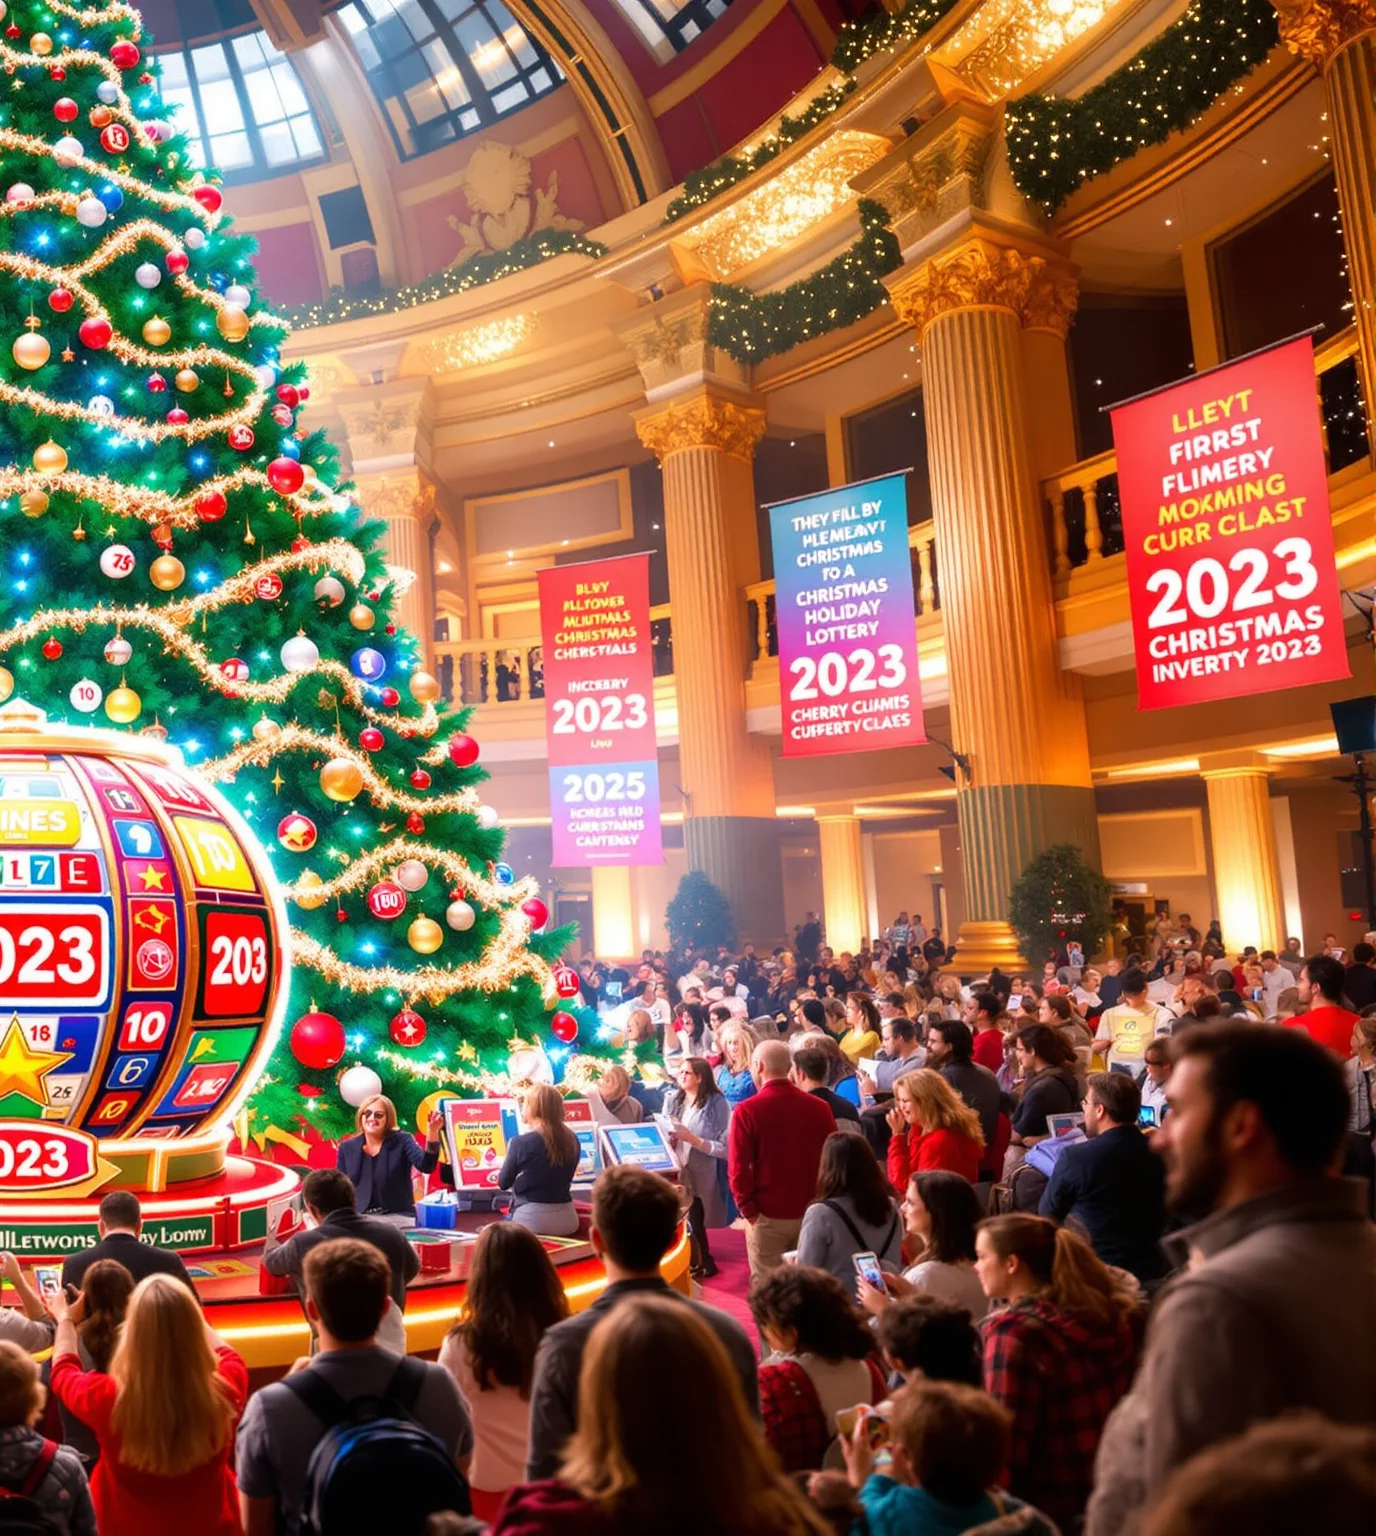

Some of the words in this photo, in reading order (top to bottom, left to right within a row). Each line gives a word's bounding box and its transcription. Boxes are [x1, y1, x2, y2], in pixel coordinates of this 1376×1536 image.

[1172, 389, 1252, 434] LLEYT
[1169, 418, 1262, 466] FIRRST
[1162, 446, 1274, 498] FLIMERY
[791, 512, 830, 532] THEY
[862, 500, 882, 518] BY
[1143, 522, 1211, 556] CURR
[1218, 497, 1306, 536] CLAST
[822, 566, 841, 581] TO
[843, 564, 856, 578] A
[1146, 536, 1318, 630] 2023
[796, 578, 888, 606] CHRISTMAS
[804, 598, 881, 625] HOLIDAY
[806, 620, 879, 646] LOTTERY
[1148, 605, 1324, 659] CHRISTMAS
[790, 644, 907, 701] 2023
[1153, 648, 1249, 684] INVERTY
[1256, 634, 1322, 666] 2023
[79, 687, 94, 701] 10
[552, 693, 648, 734] 2023
[791, 703, 848, 722] CHERRY
[862, 713, 912, 732] CLAES
[563, 772, 646, 803] 2025
[34, 860, 51, 881] 7
[68, 858, 88, 885] E
[210, 935, 267, 986] 203
[126, 1010, 166, 1044] 10
[119, 1058, 149, 1084] 6
